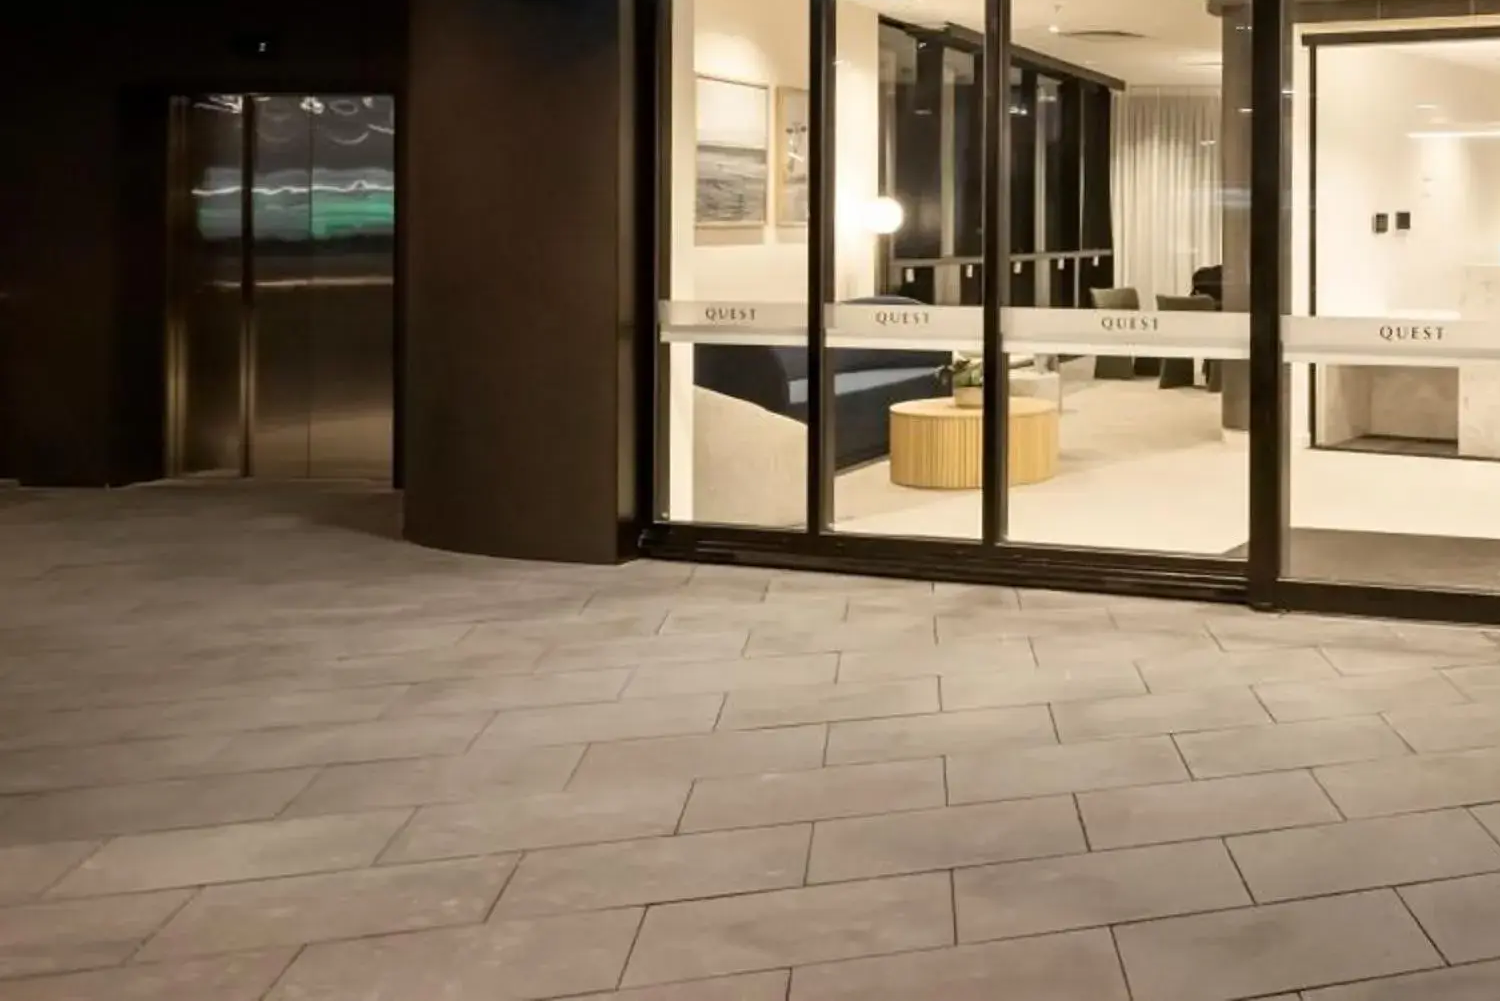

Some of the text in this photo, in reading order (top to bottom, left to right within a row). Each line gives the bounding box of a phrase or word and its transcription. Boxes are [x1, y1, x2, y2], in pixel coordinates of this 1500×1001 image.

[705, 307, 757, 321] QUEST
[876, 311, 930, 324] QUEST
[1101, 316, 1159, 330] QUEST
[1379, 325, 1445, 341] QUEST
